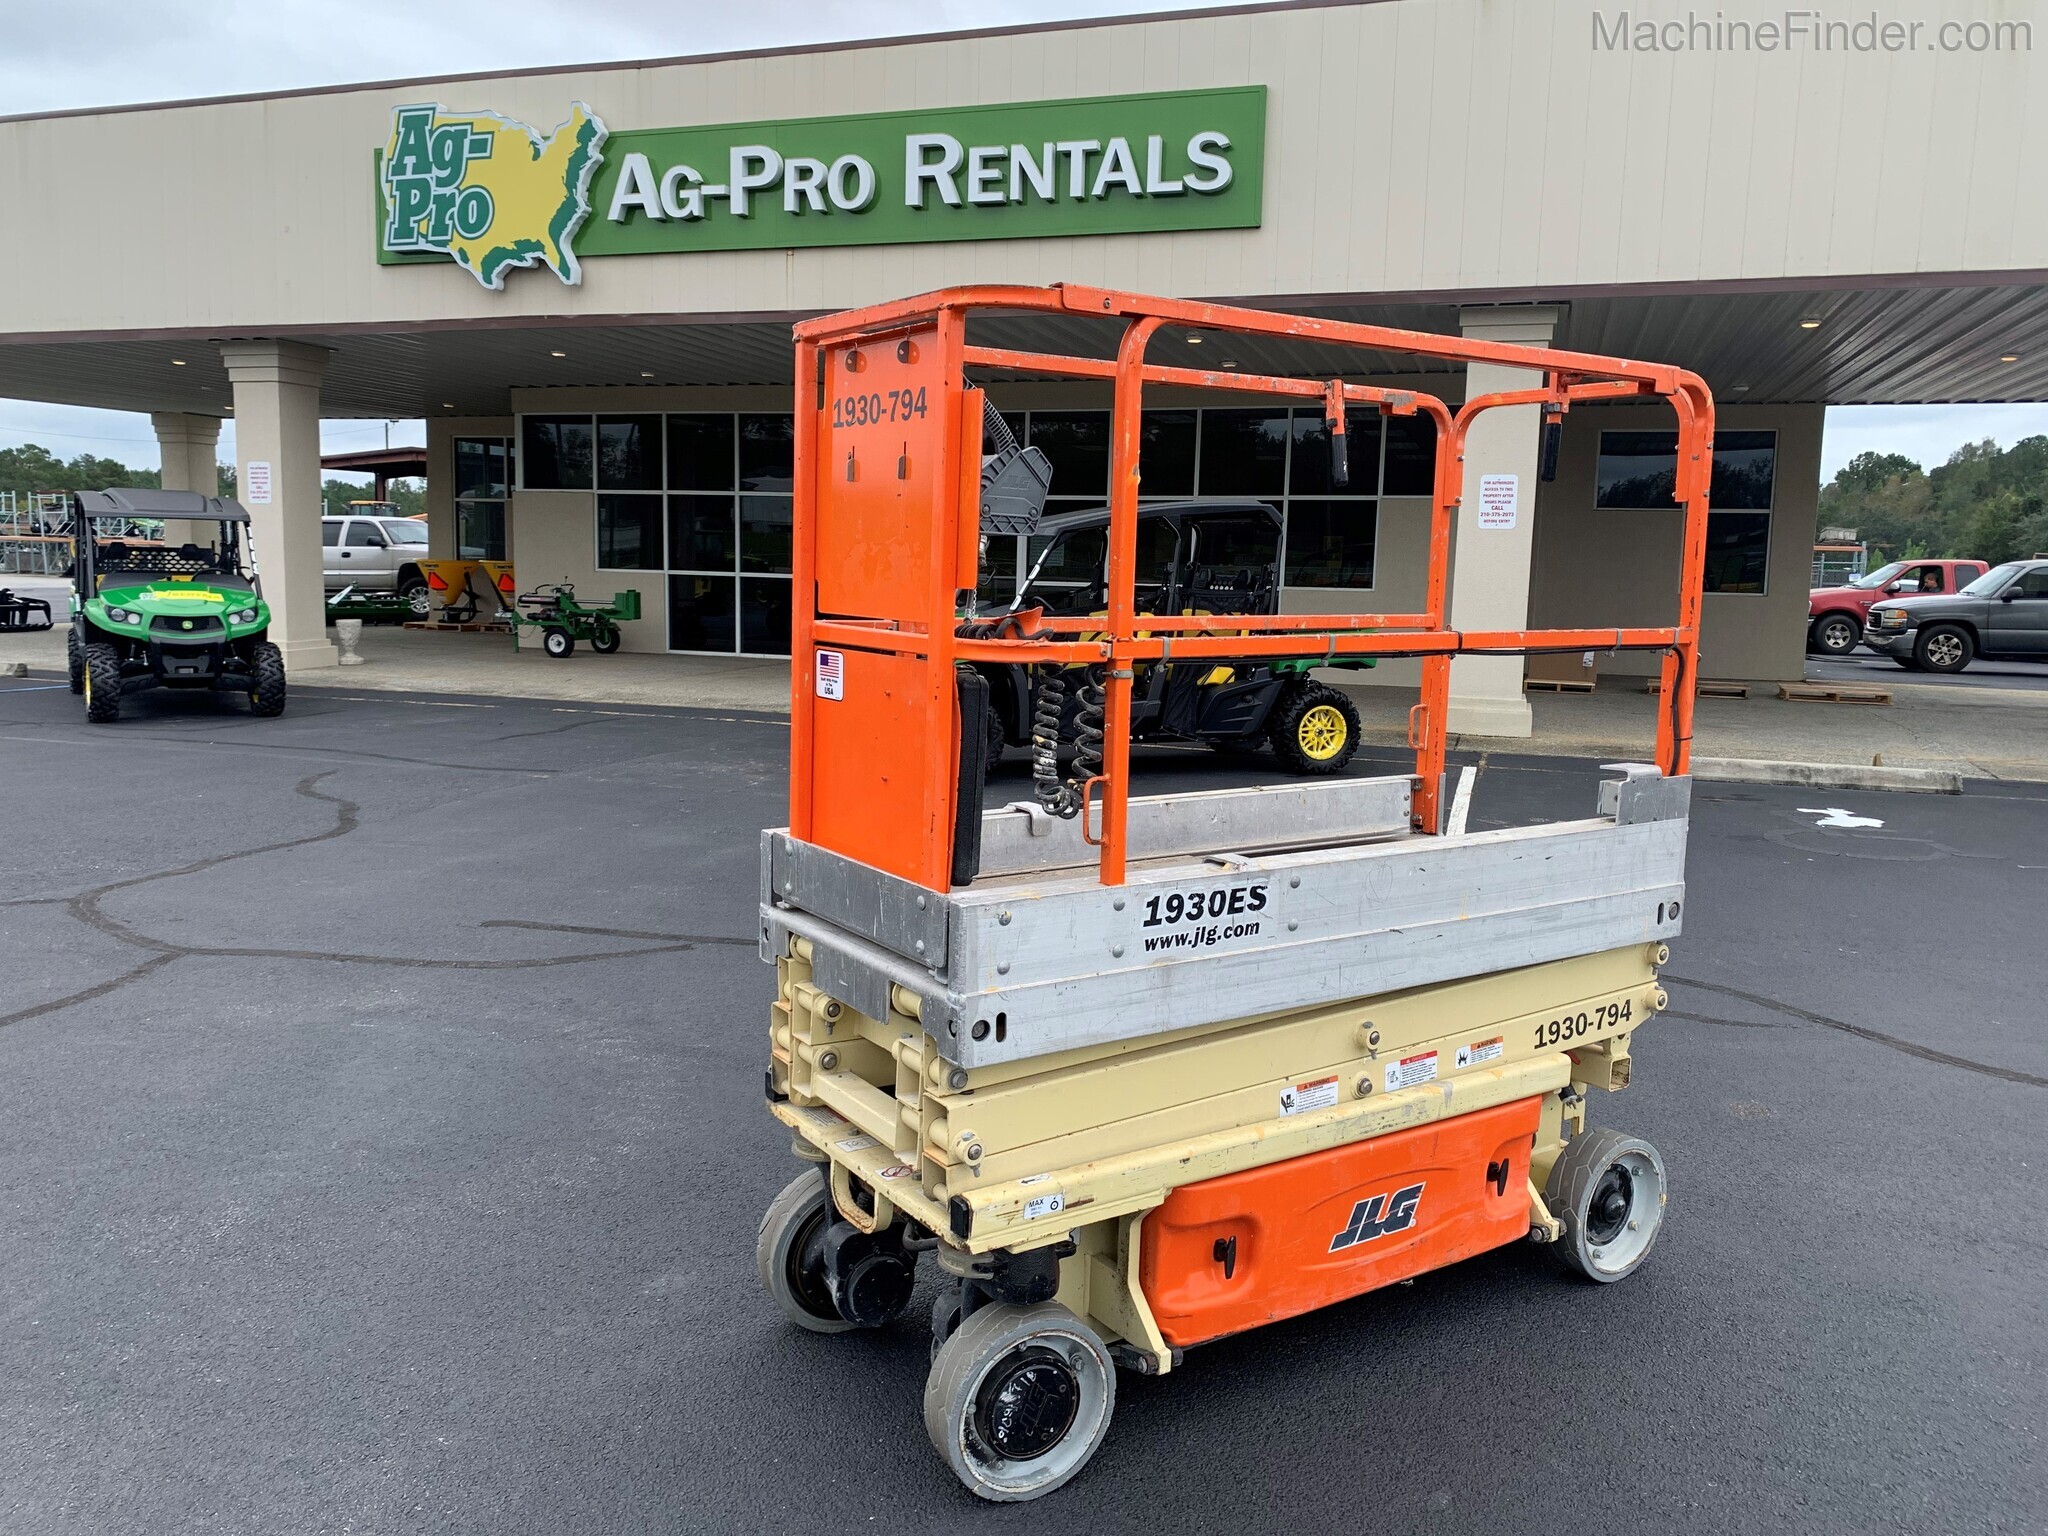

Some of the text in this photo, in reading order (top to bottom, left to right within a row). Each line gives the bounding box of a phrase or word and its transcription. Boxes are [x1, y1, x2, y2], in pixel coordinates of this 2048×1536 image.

[387, 107, 495, 189] Ag-
[388, 176, 494, 246] Pro
[833, 386, 928, 428] 1930-794
[824, 687, 834, 695] USA
[1143, 884, 1269, 927] 1930ES
[1145, 921, 1260, 952] www.jlg.com
[1534, 999, 1632, 1049] 1930-794
[1028, 1198, 1045, 1208] MAX
[1328, 1181, 1427, 1254] JLG
